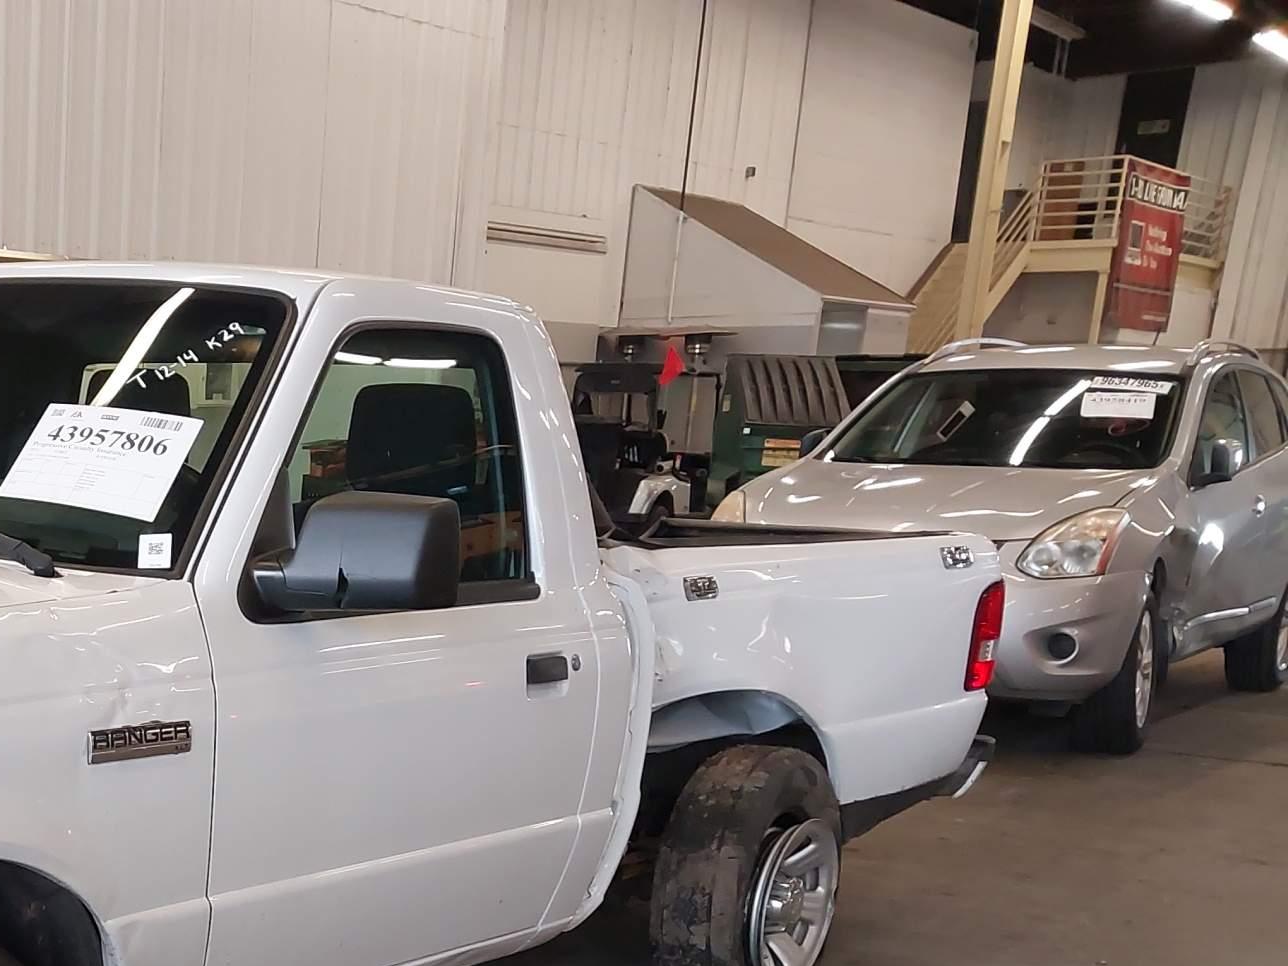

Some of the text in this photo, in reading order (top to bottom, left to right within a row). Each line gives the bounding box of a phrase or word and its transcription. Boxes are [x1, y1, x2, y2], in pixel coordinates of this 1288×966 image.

[126, 368, 147, 389] T
[154, 349, 199, 380] 12-14
[47, 424, 172, 456] 43957806
[93, 725, 190, 750] RANGER
